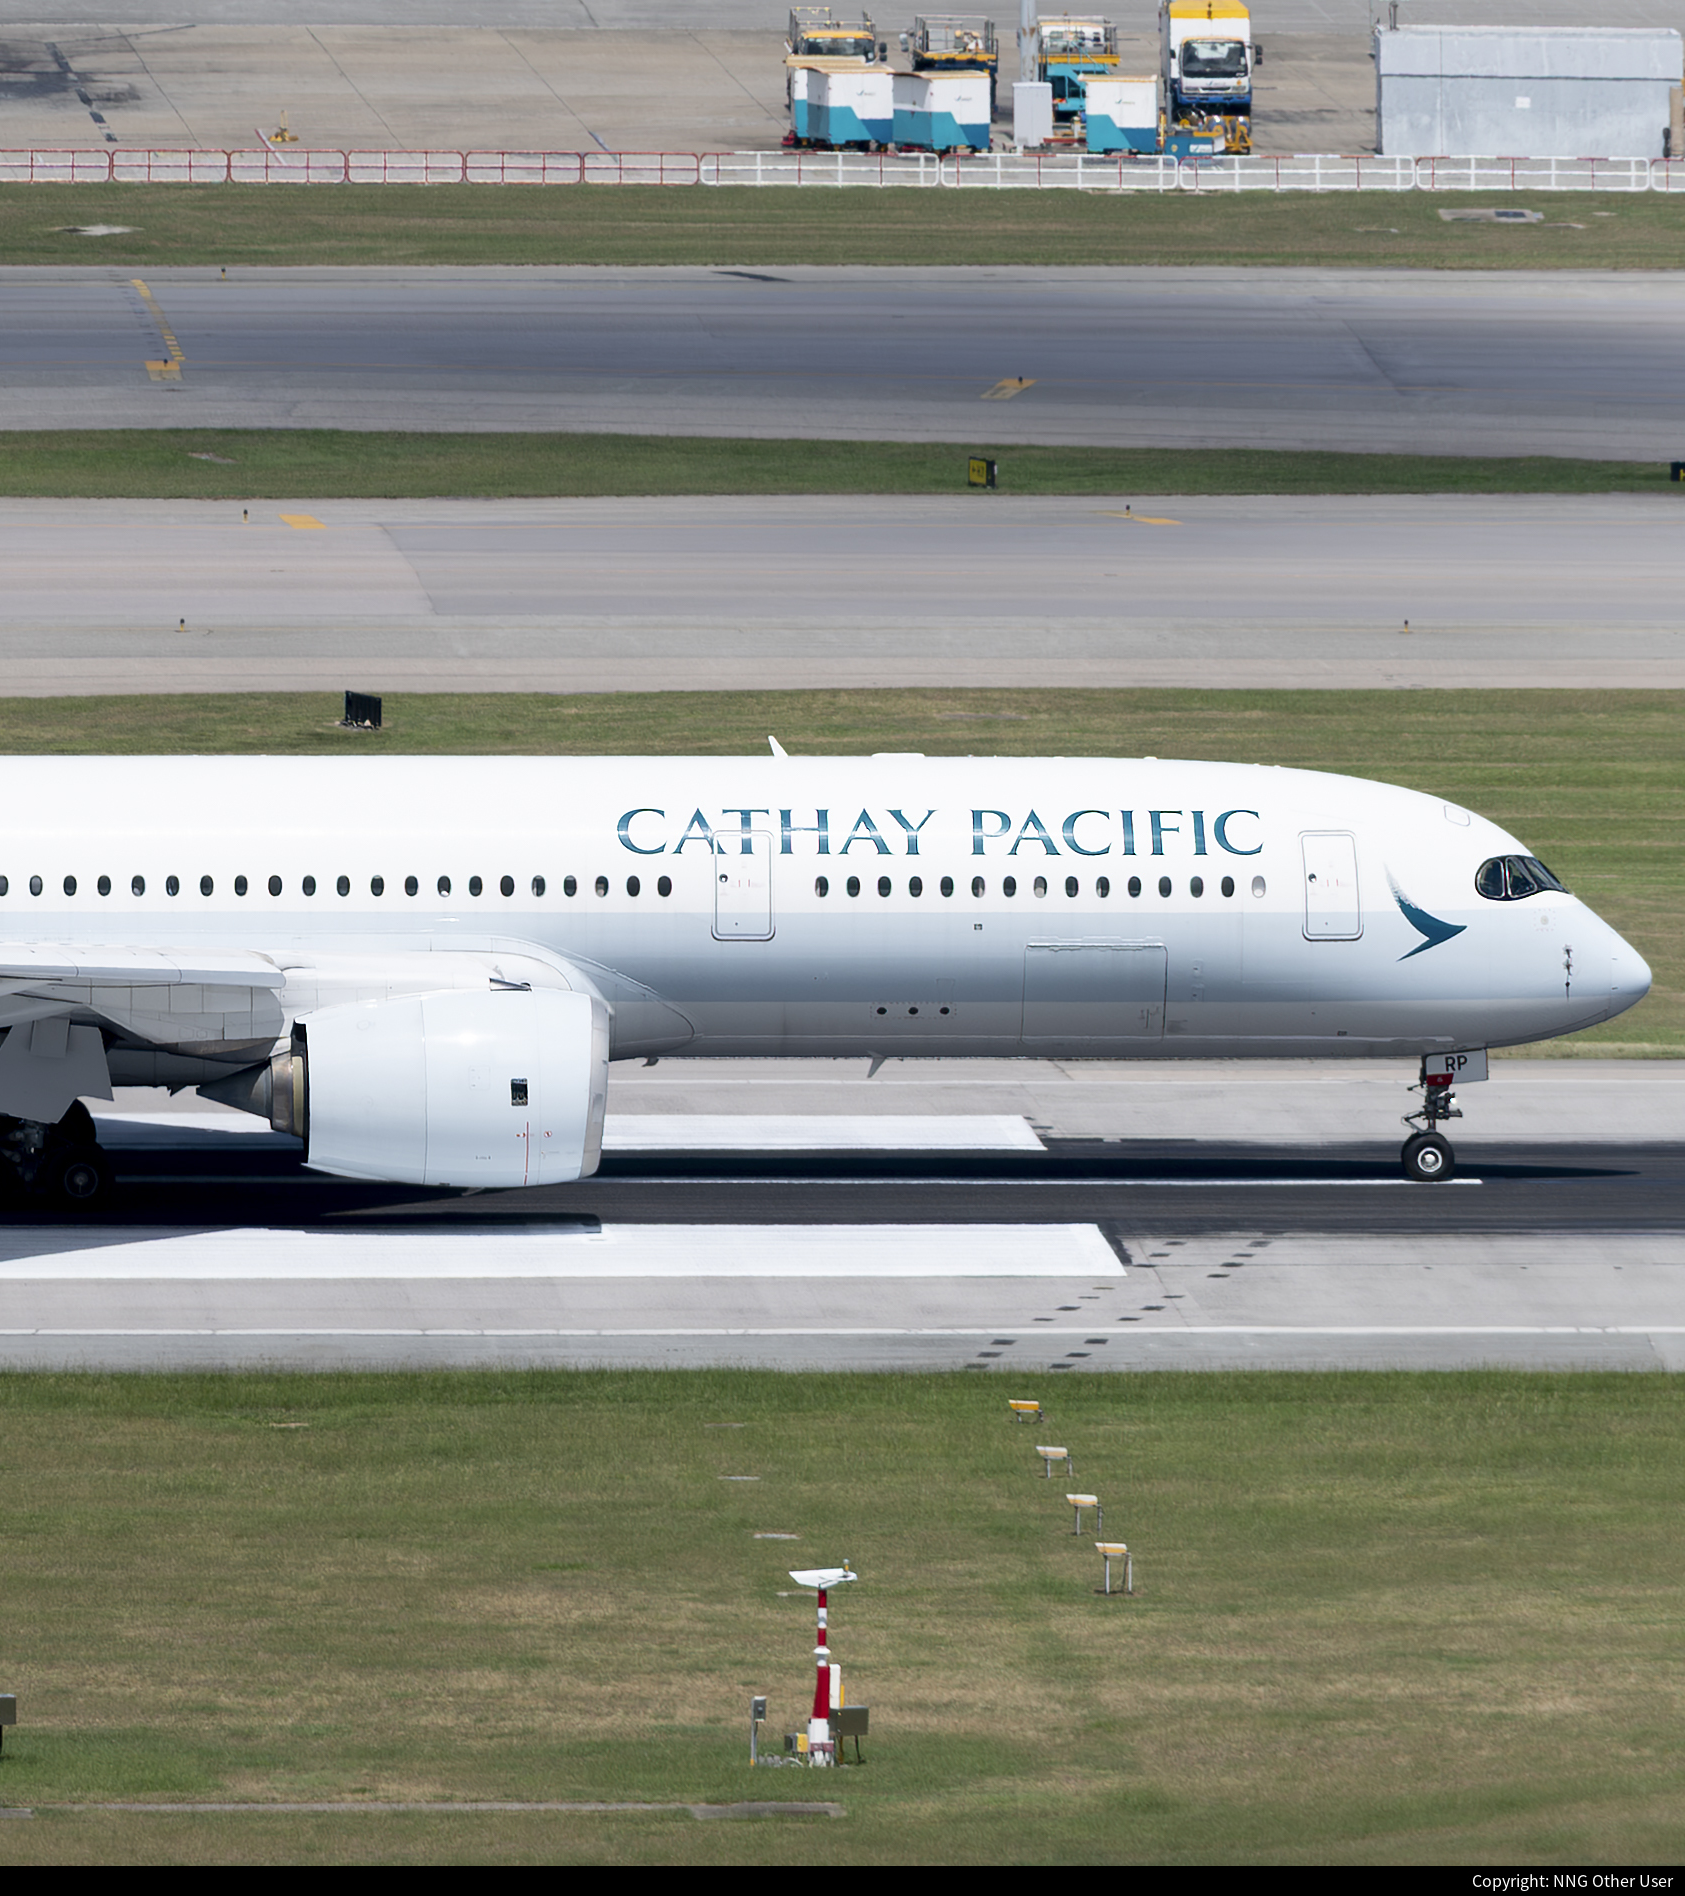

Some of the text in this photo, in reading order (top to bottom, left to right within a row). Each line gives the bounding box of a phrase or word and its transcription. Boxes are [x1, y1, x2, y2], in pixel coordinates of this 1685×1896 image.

[616, 808, 1264, 856] CATHAY PACIFIC
[1444, 1054, 1468, 1072] RP
